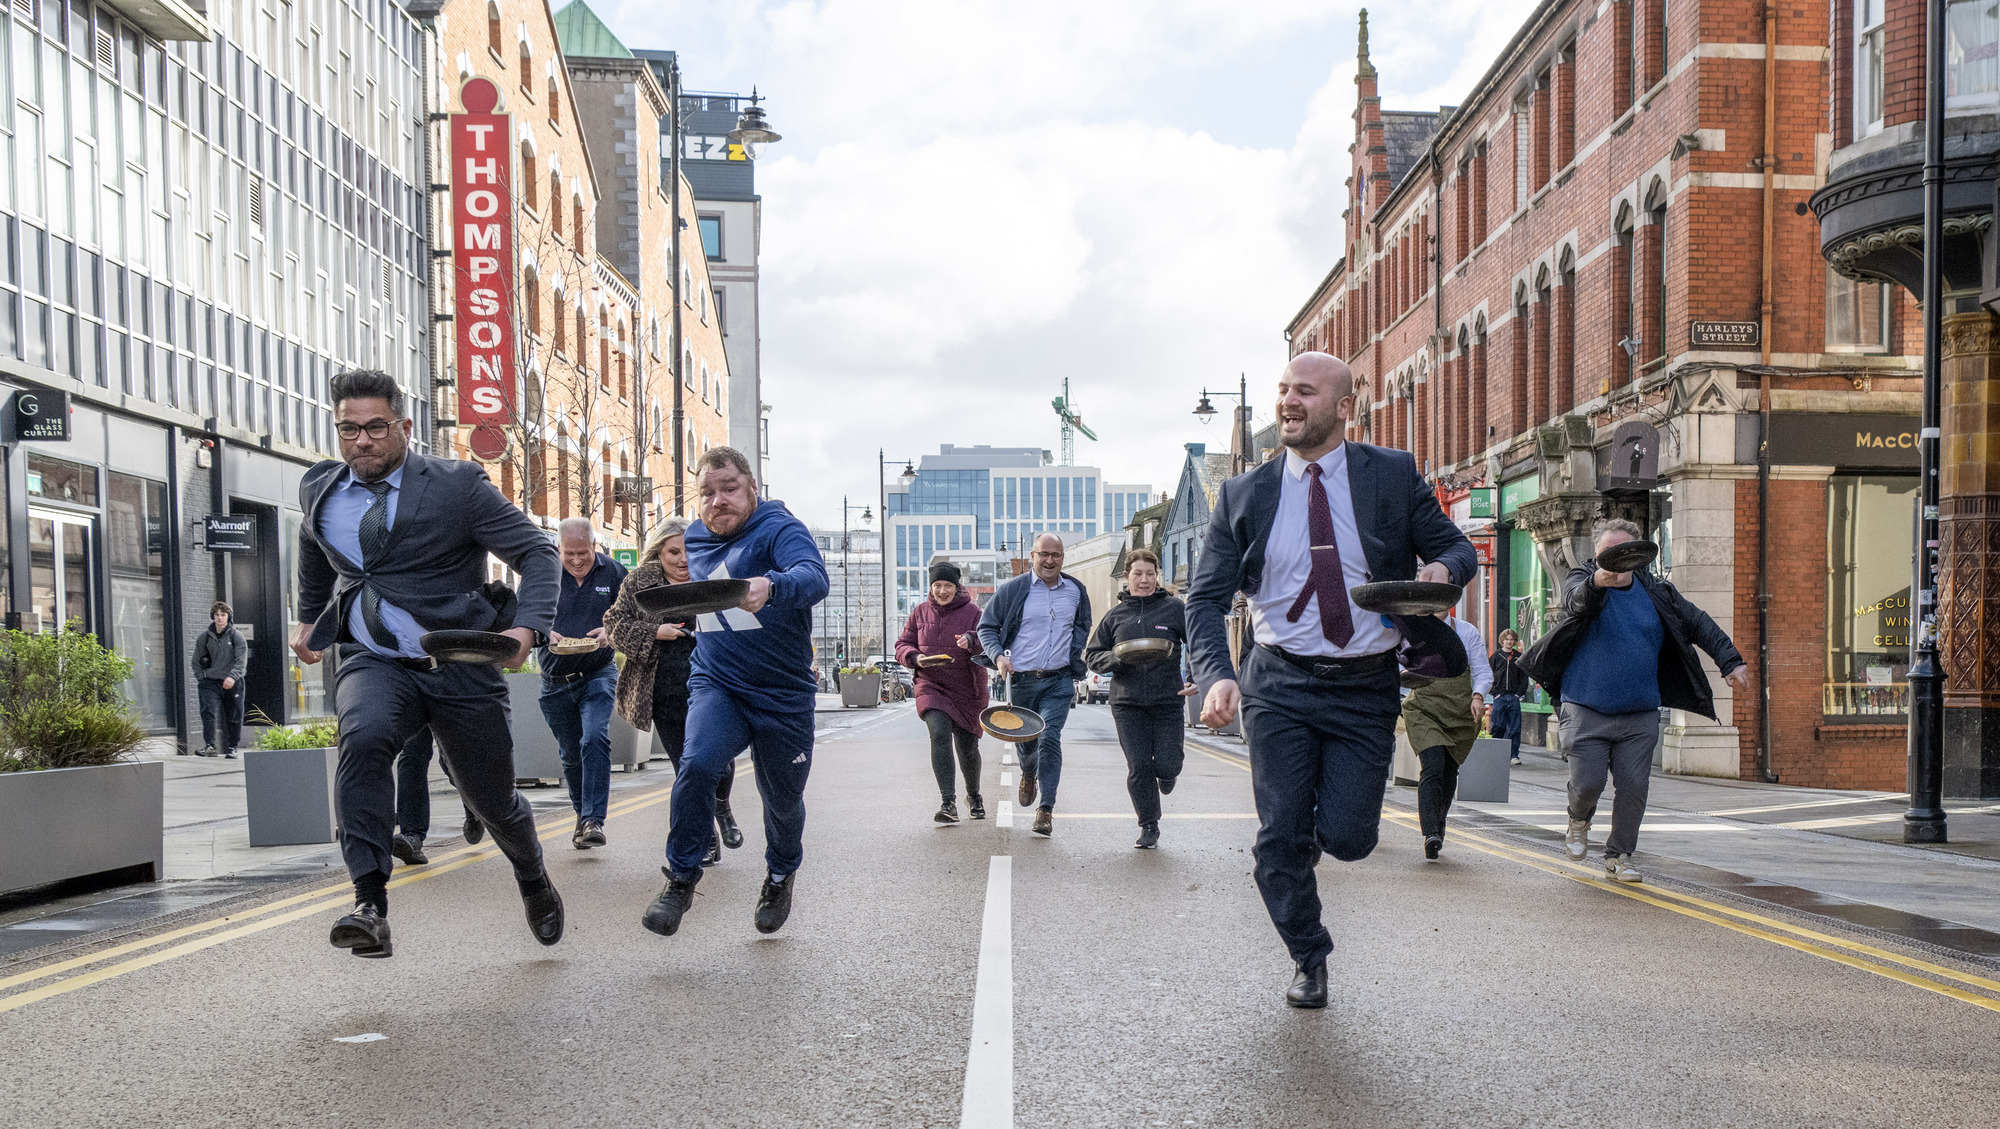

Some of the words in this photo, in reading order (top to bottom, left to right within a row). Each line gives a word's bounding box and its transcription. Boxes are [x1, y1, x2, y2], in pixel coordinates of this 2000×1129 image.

[464, 124, 503, 415] THOMPSONS
[1697, 324, 1753, 333] HARLEYS
[1702, 333, 1747, 342] STREET
[1472, 501, 1489, 509] post
[208, 520, 251, 530] Marriott
